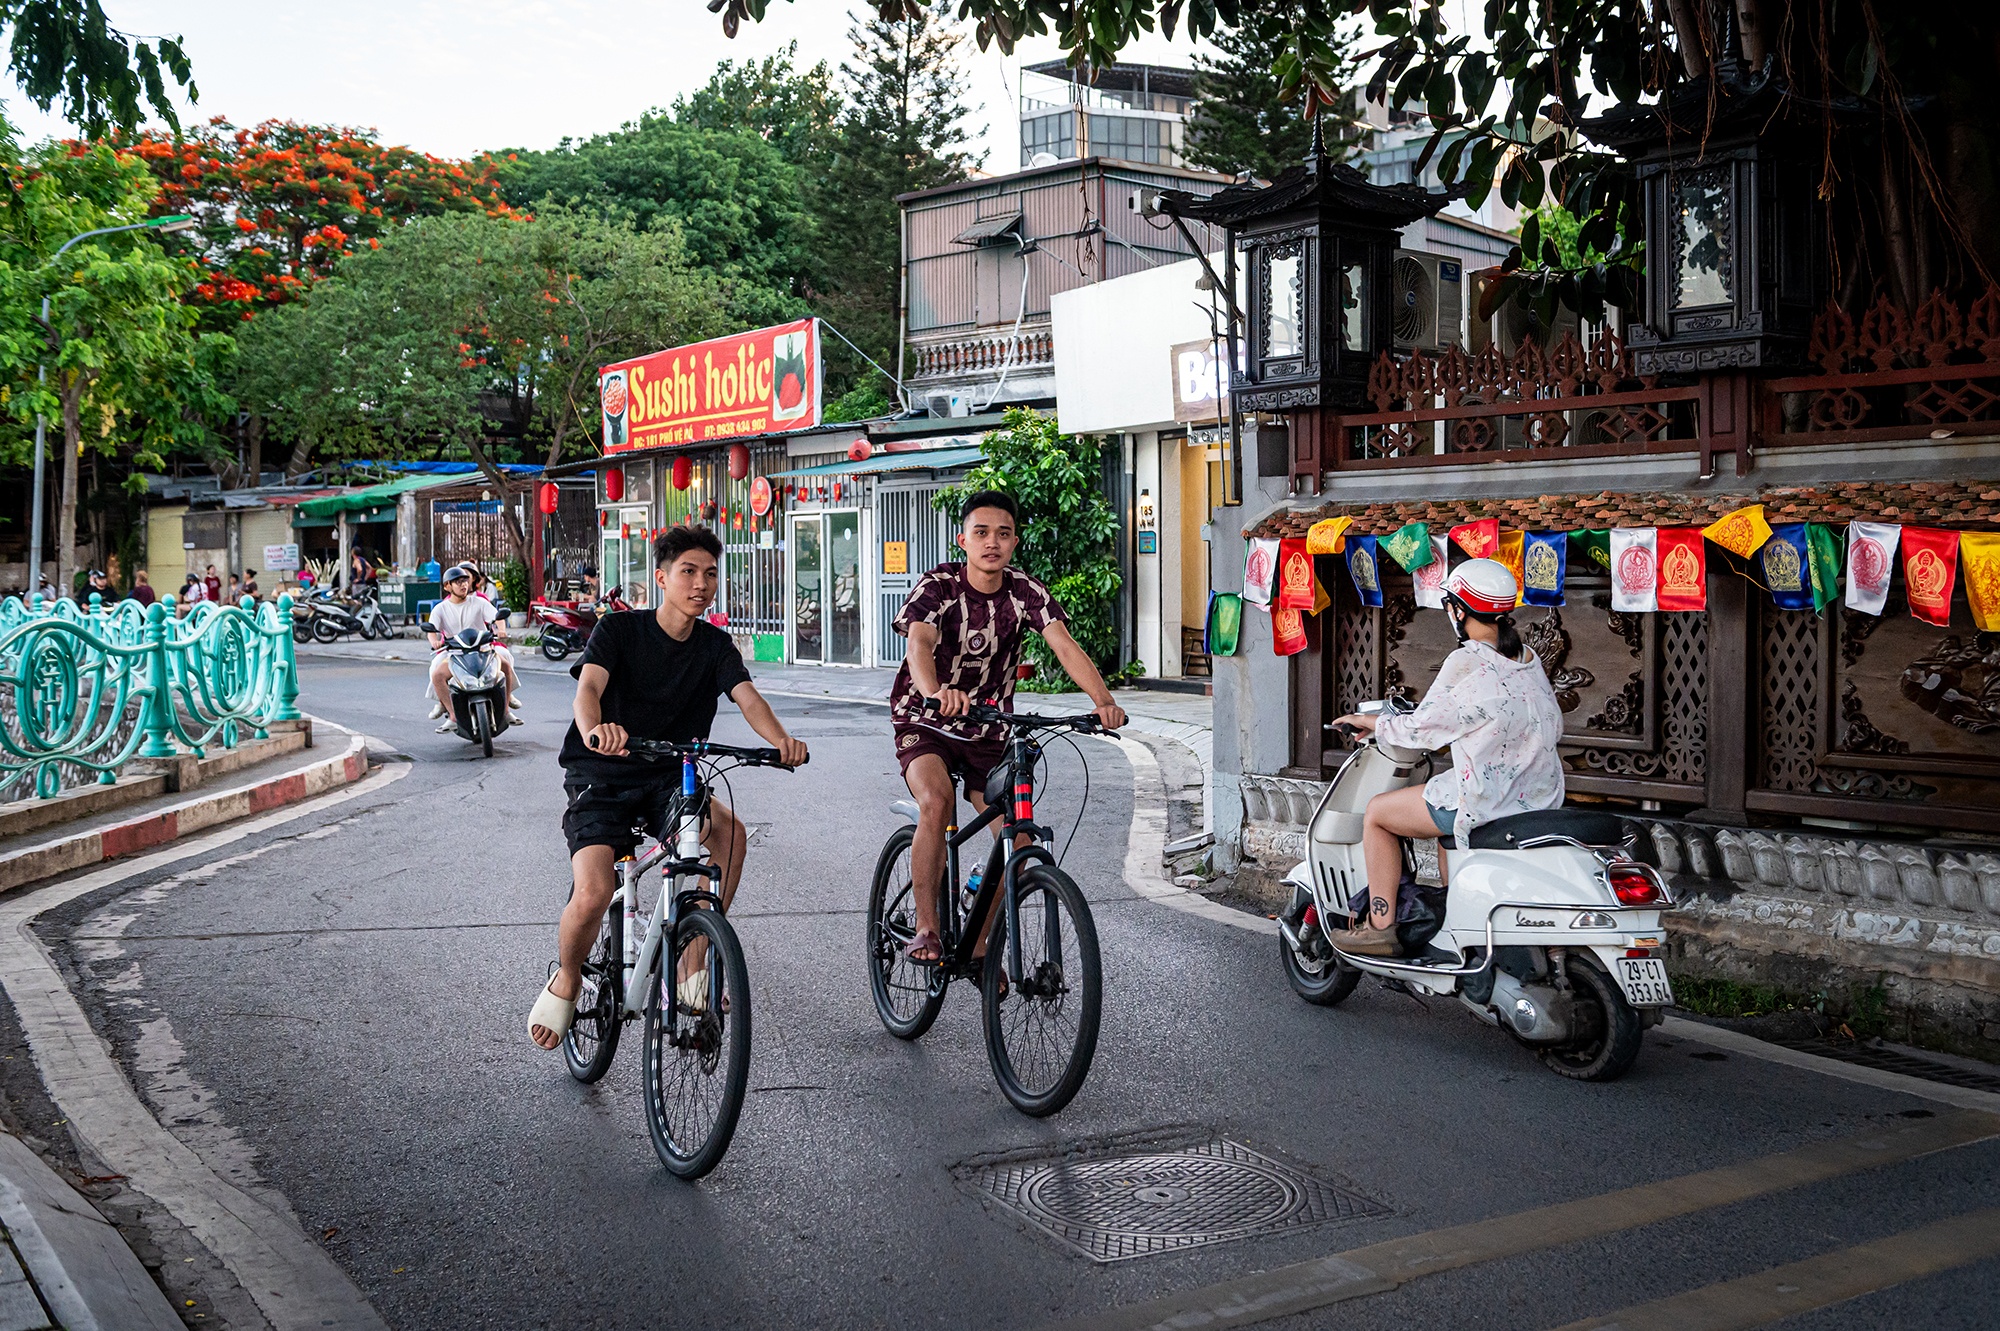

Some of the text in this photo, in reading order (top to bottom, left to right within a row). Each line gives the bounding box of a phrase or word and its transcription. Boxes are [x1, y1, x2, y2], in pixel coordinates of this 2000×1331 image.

[630, 343, 771, 422] Sushi holic
[736, 420, 750, 433] 434
[1140, 505, 1153, 516] 185
[1515, 910, 1556, 927] Vespa
[1627, 983, 1671, 1003] 353.64
